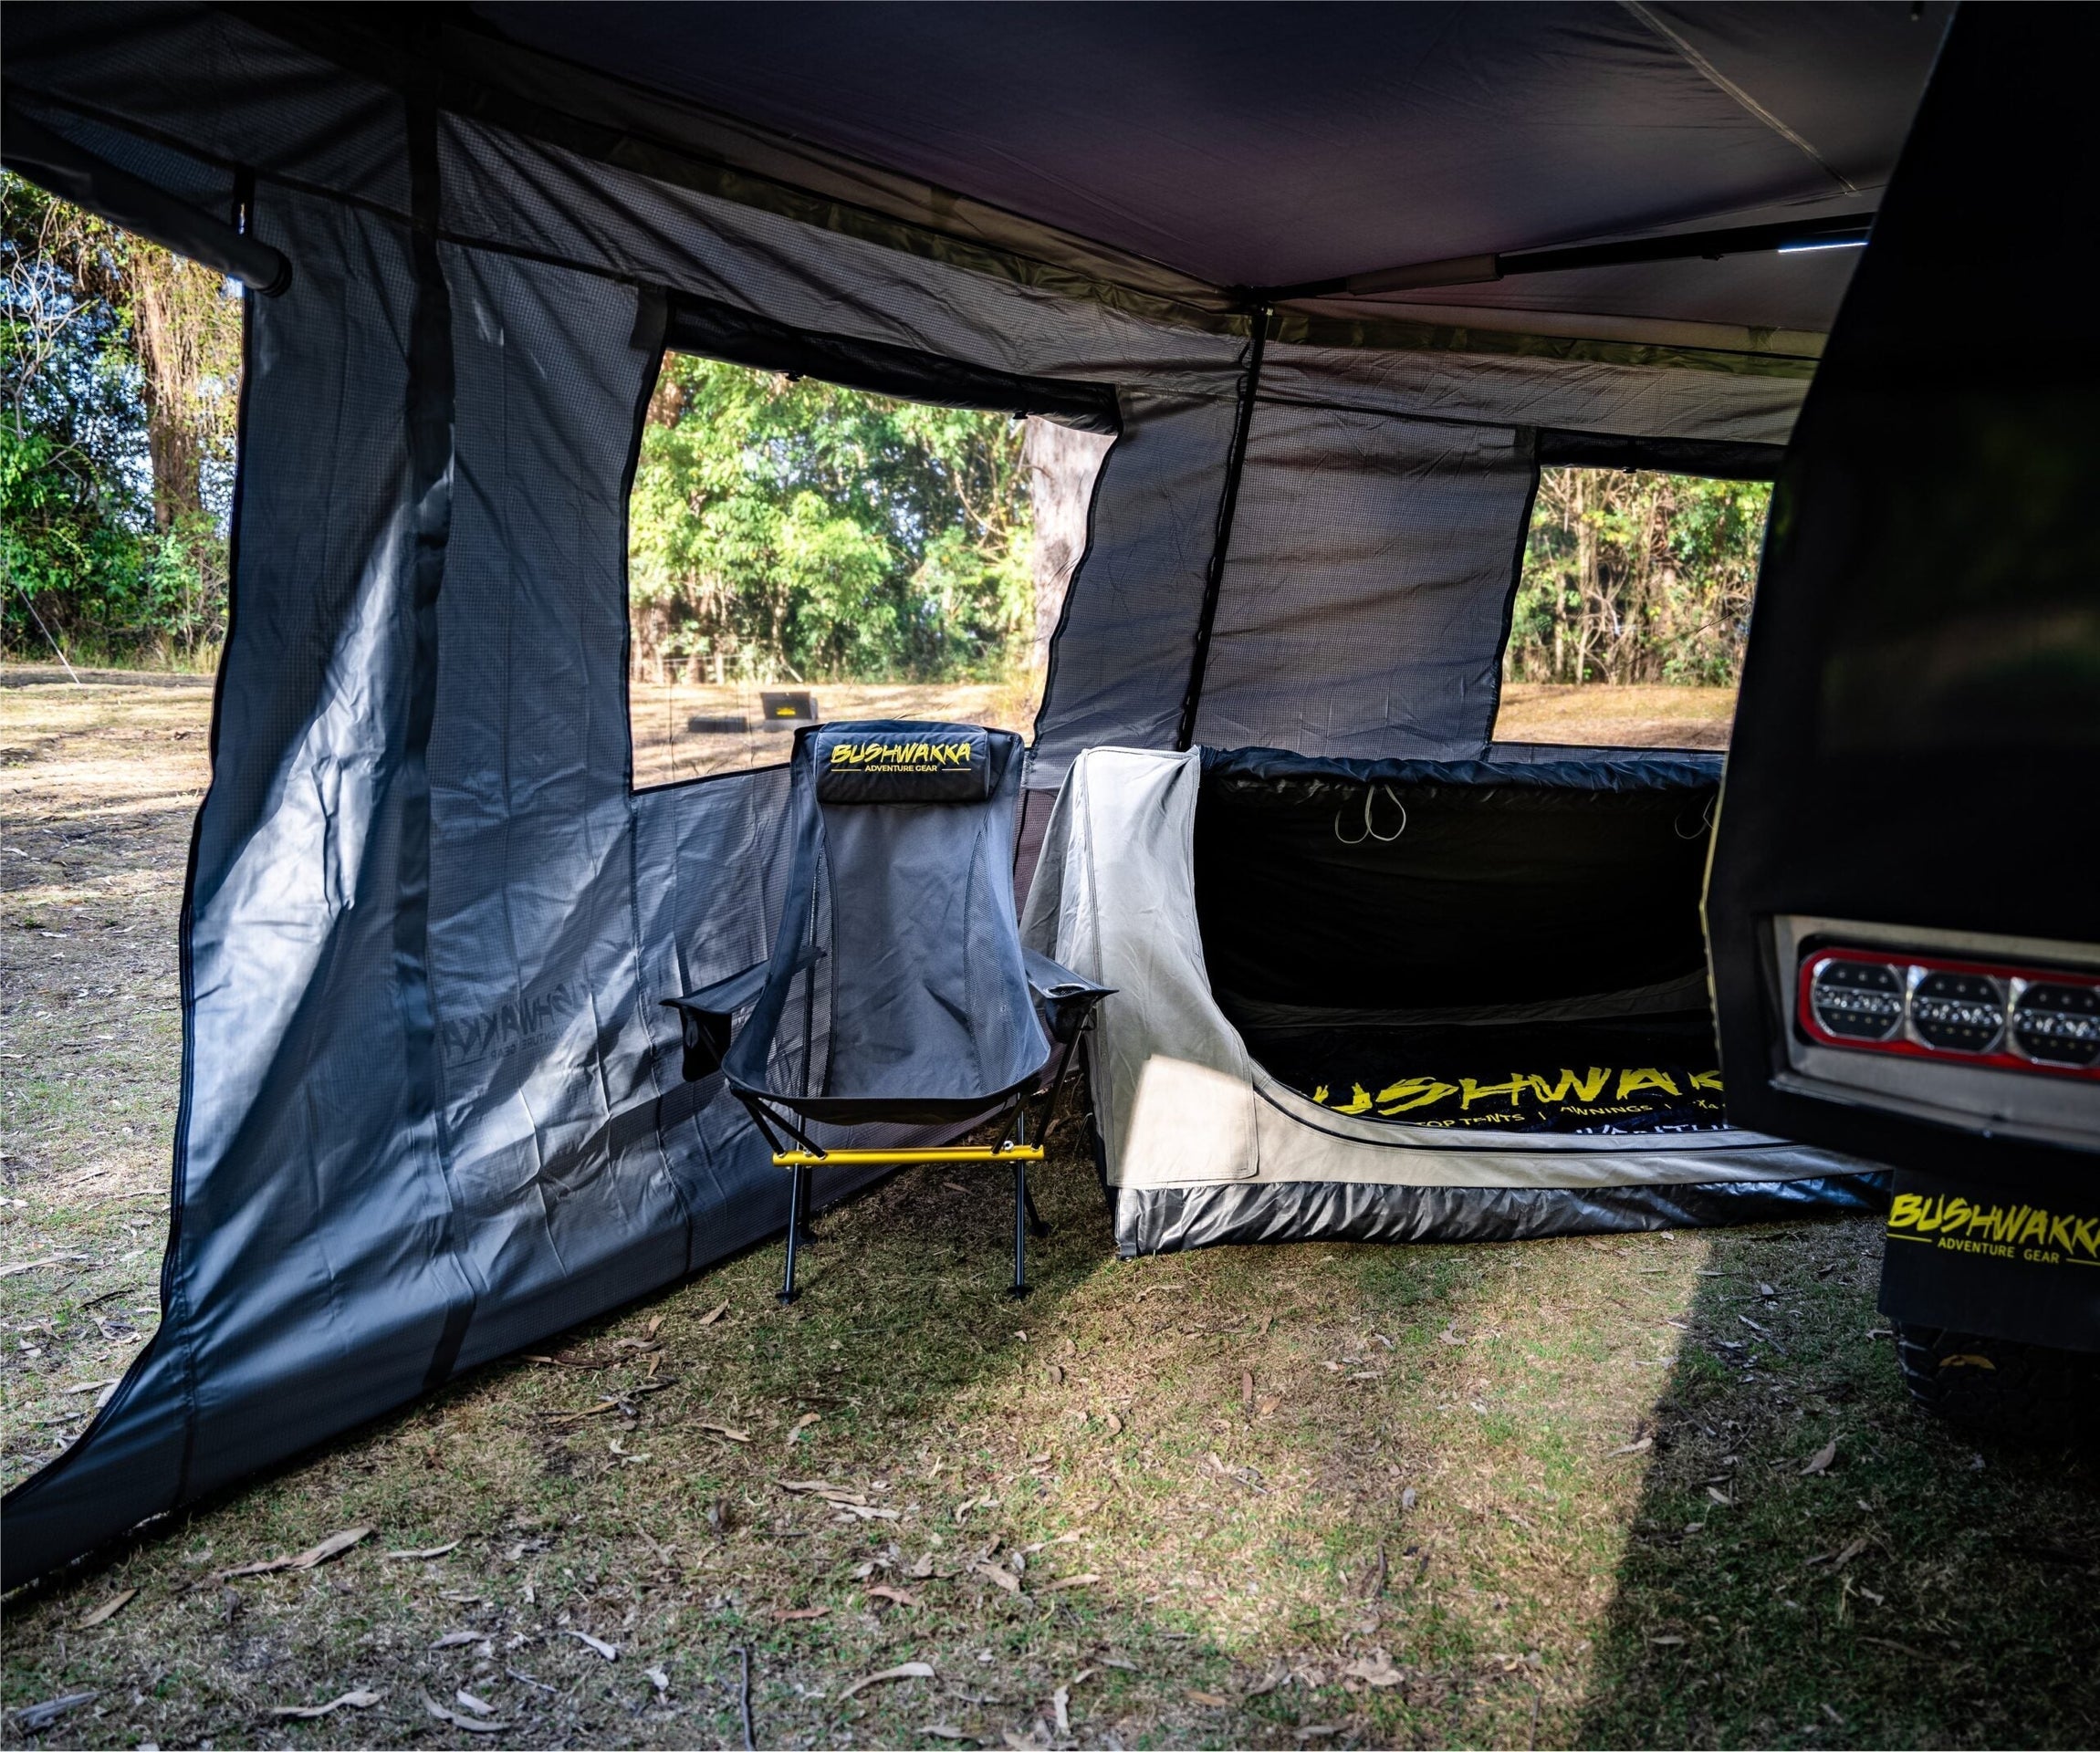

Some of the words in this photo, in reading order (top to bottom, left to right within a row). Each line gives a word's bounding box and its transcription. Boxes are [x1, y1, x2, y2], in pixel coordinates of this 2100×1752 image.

[831, 742, 971, 765] BUSHWAKKA
[1887, 1193, 2100, 1258] BUSHWAKK
[1938, 1236, 2015, 1258] ADVENTURE
[2023, 1248, 2060, 1264] GEAR
